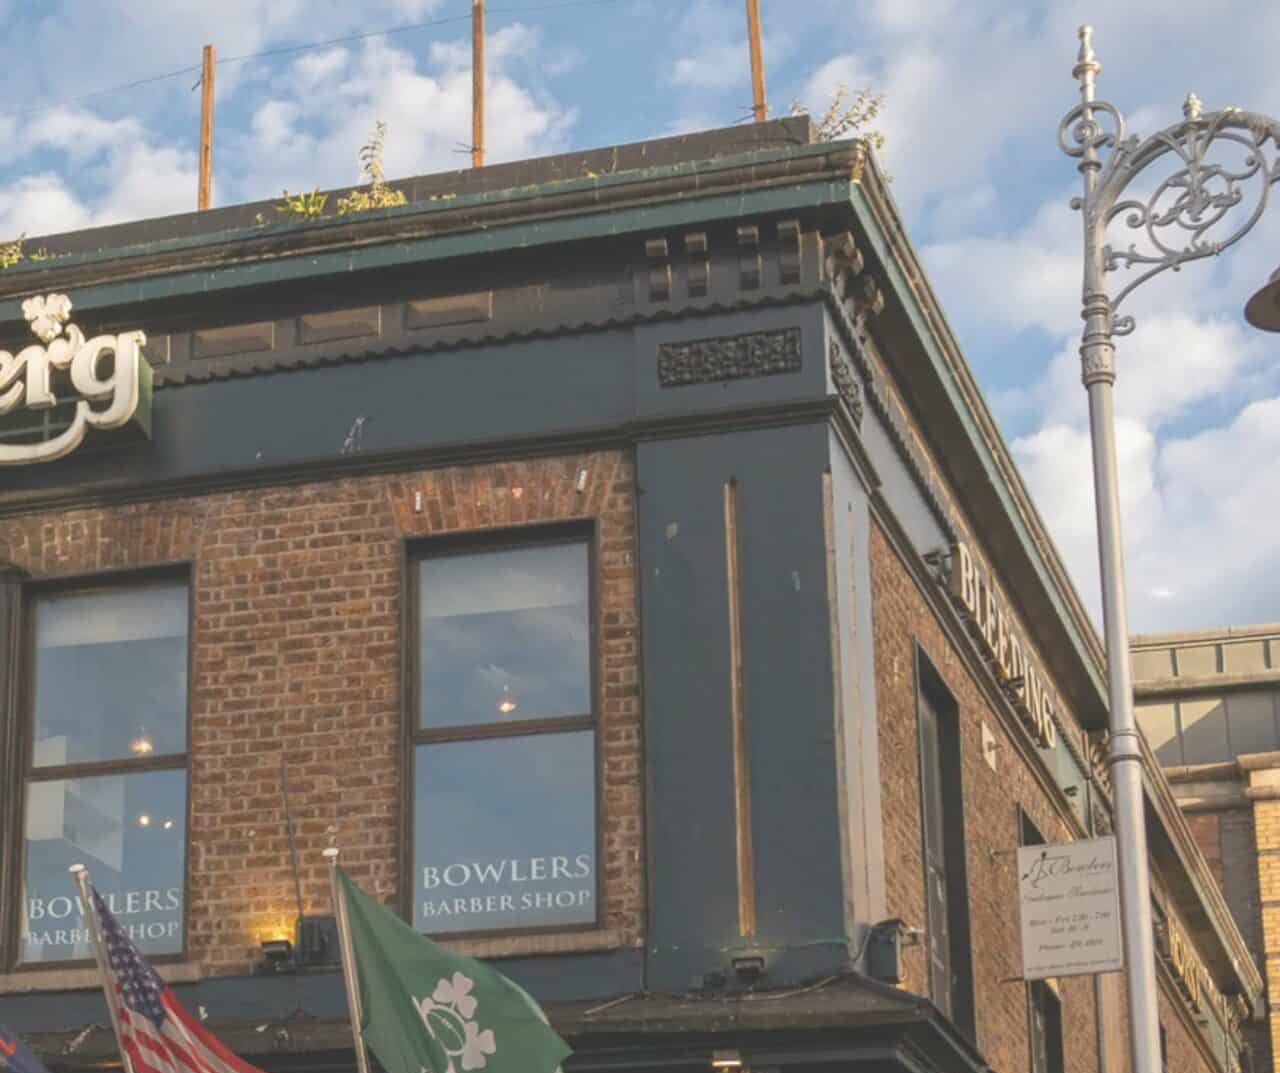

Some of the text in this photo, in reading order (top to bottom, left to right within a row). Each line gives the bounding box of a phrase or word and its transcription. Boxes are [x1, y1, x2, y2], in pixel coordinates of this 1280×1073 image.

[958, 541, 1056, 749] BLEEDING
[424, 855, 590, 889] BOWLERS
[423, 888, 591, 918] BARBER SHOP
[120, 920, 179, 942] HOP
